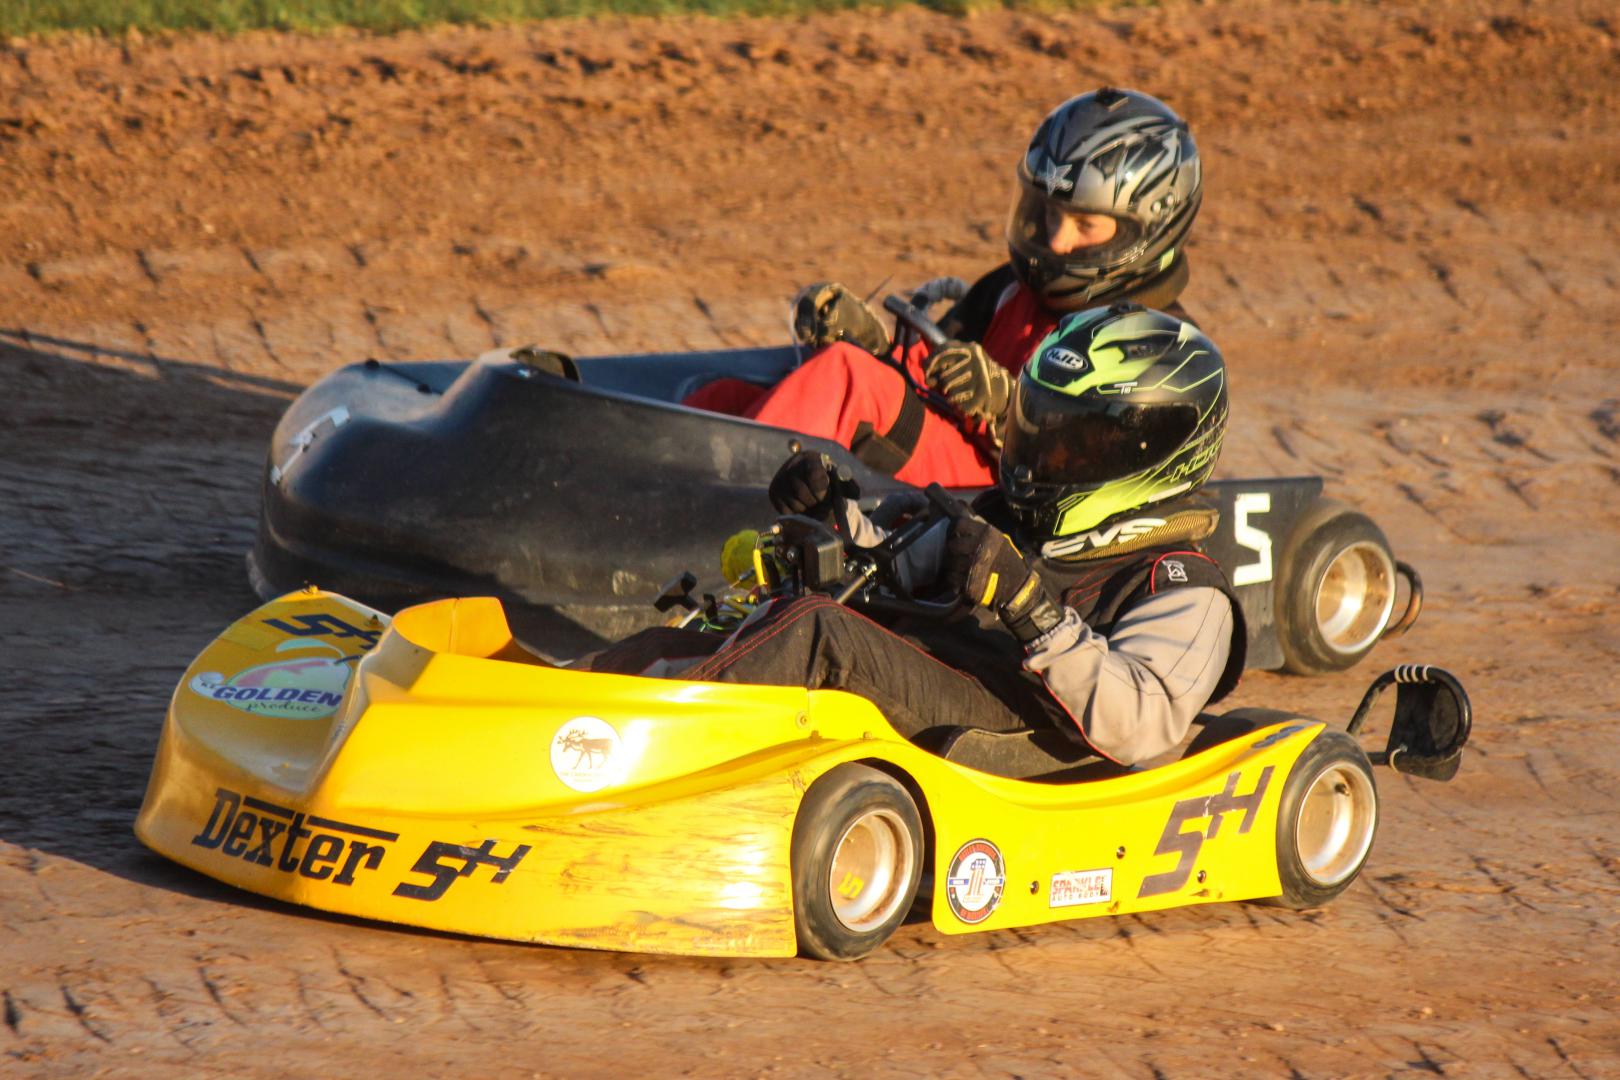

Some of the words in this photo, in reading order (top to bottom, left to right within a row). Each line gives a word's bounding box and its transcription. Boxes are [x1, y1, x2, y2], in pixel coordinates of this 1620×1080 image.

[1041, 518, 1167, 558] EVS
[1233, 493, 1273, 587] 5
[213, 686, 343, 706] GOLDEN
[191, 787, 399, 887] Dexter
